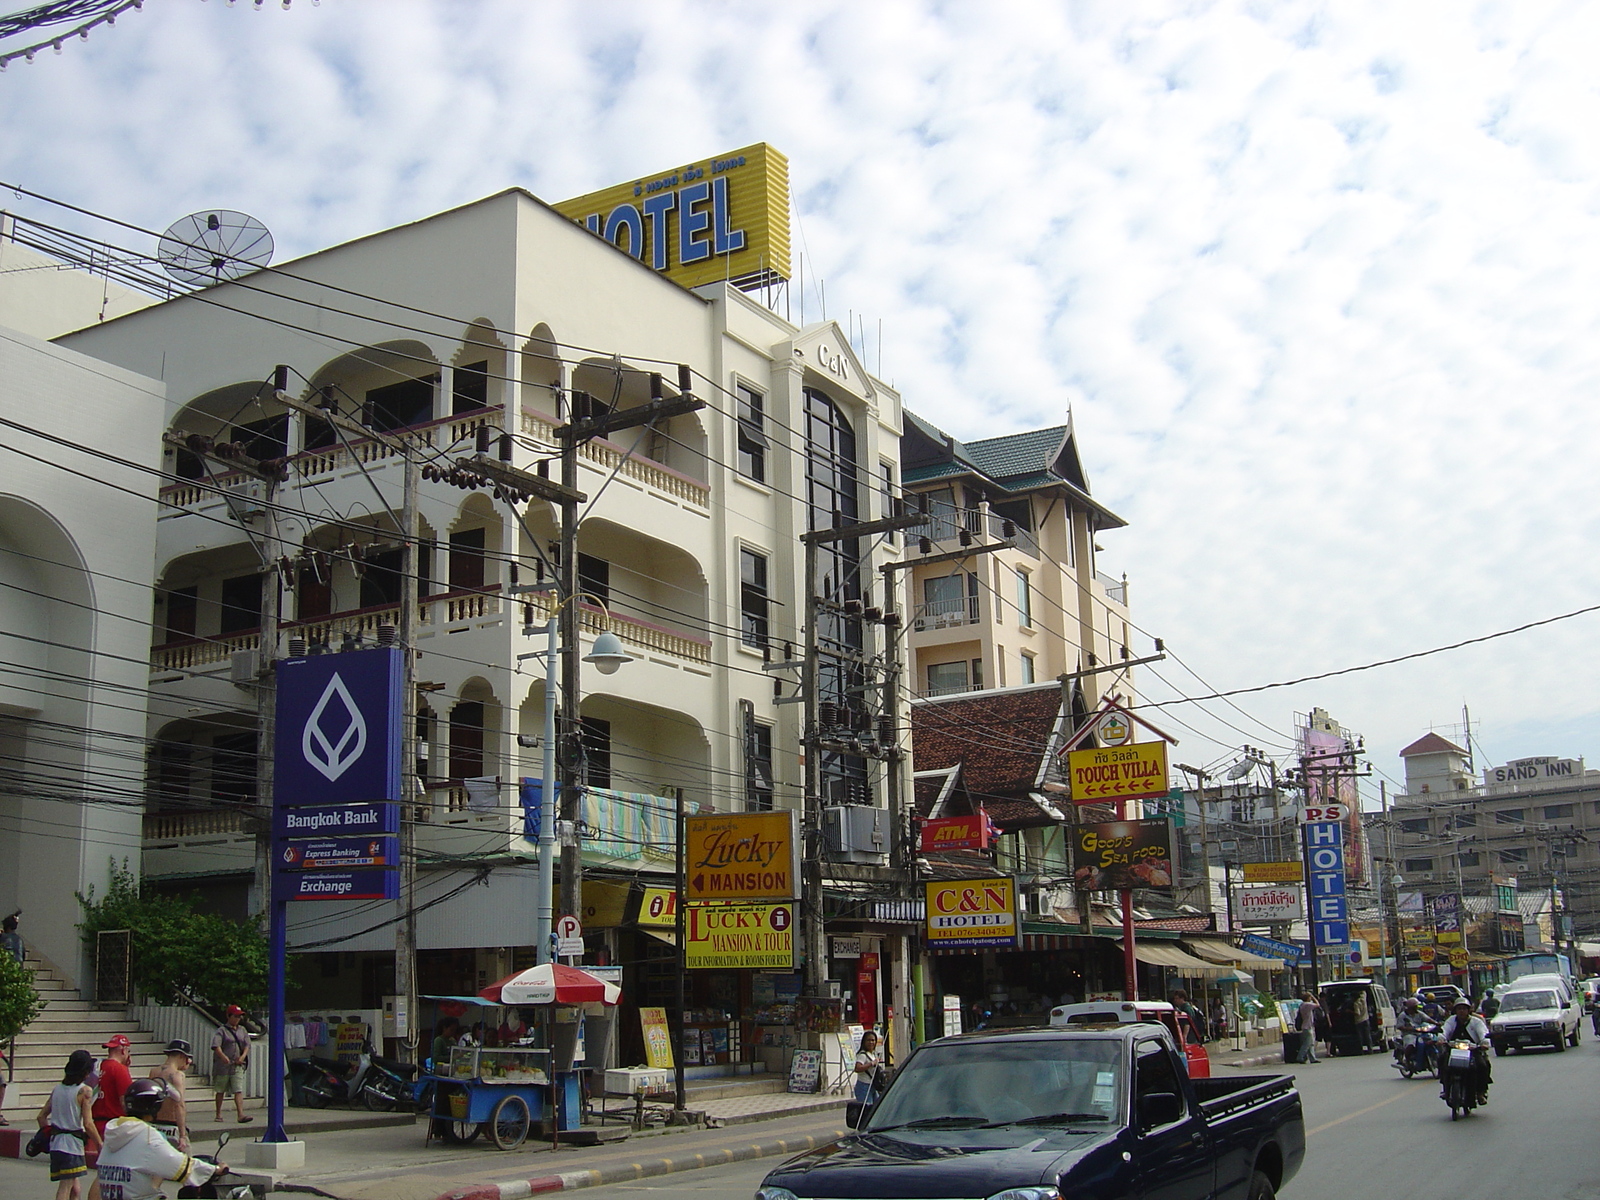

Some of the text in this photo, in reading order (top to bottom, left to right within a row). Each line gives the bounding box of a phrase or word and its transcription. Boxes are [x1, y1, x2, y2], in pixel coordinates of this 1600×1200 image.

[818, 343, 849, 380] C&N
[1076, 759, 1161, 784] TOUCH VILLA
[1496, 762, 1572, 782] SAND INN
[286, 809, 378, 830] Bangkok Bank
[934, 825, 969, 841] ATM
[305, 848, 360, 859] Express Banking
[695, 829, 784, 869] Lucky
[1132, 846, 1166, 861] FOOD
[300, 880, 352, 894] Exchange
[710, 872, 786, 891] MANSION
[1313, 824, 1343, 943] HOTEL
[935, 888, 1007, 913] C&N
[564, 921, 576, 938] P
[688, 908, 766, 942] LUCKY
[939, 915, 1006, 926] HOTEL
[712, 932, 791, 952] MANSION & TOUR
[688, 956, 702, 967] TOUR
[703, 956, 739, 967] INFORMATION
[745, 955, 765, 966] ROOMS
[765, 955, 776, 966] FOR
[777, 954, 791, 965] RENT
